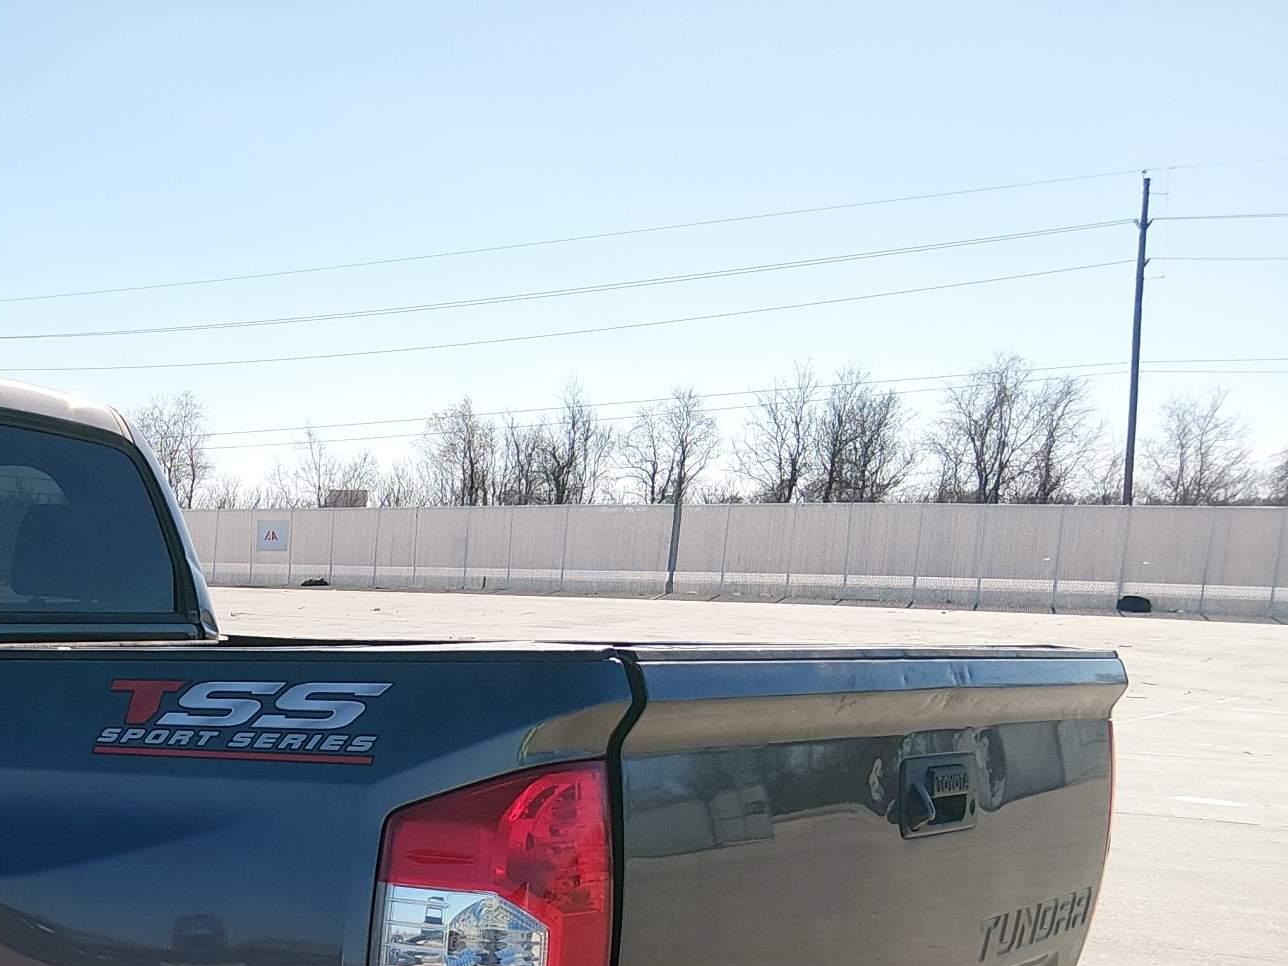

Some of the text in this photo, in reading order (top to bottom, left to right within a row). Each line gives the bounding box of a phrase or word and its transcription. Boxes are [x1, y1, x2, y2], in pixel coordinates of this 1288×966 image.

[111, 679, 394, 730] TSS
[97, 727, 377, 752] SPORT SERIES
[979, 886, 1092, 963] TUNDRA
